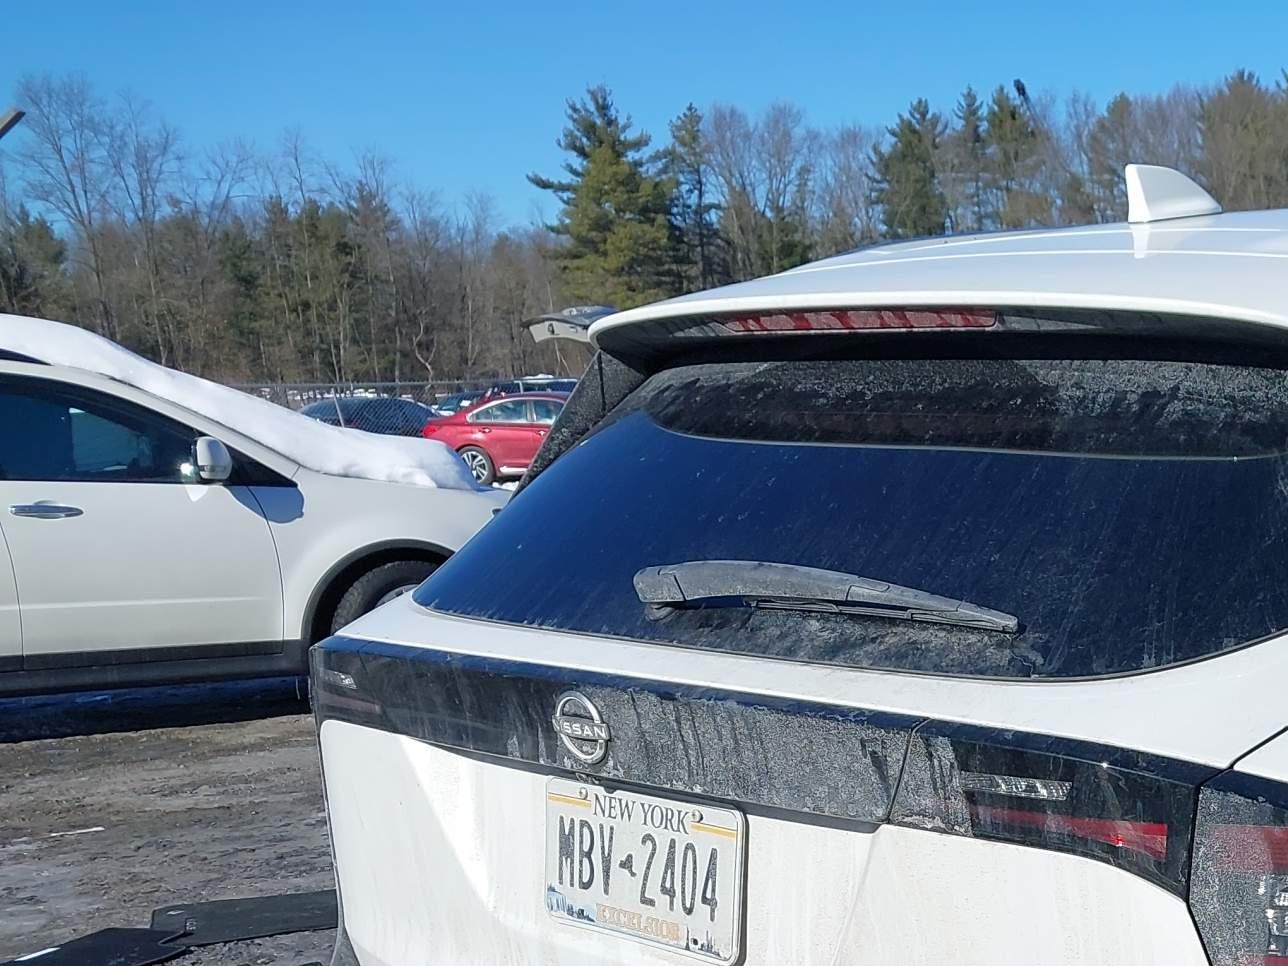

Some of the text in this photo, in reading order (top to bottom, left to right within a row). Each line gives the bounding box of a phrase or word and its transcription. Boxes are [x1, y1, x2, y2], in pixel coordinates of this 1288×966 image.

[552, 717, 607, 740] NISSAN
[592, 793, 691, 835] NEW YORK
